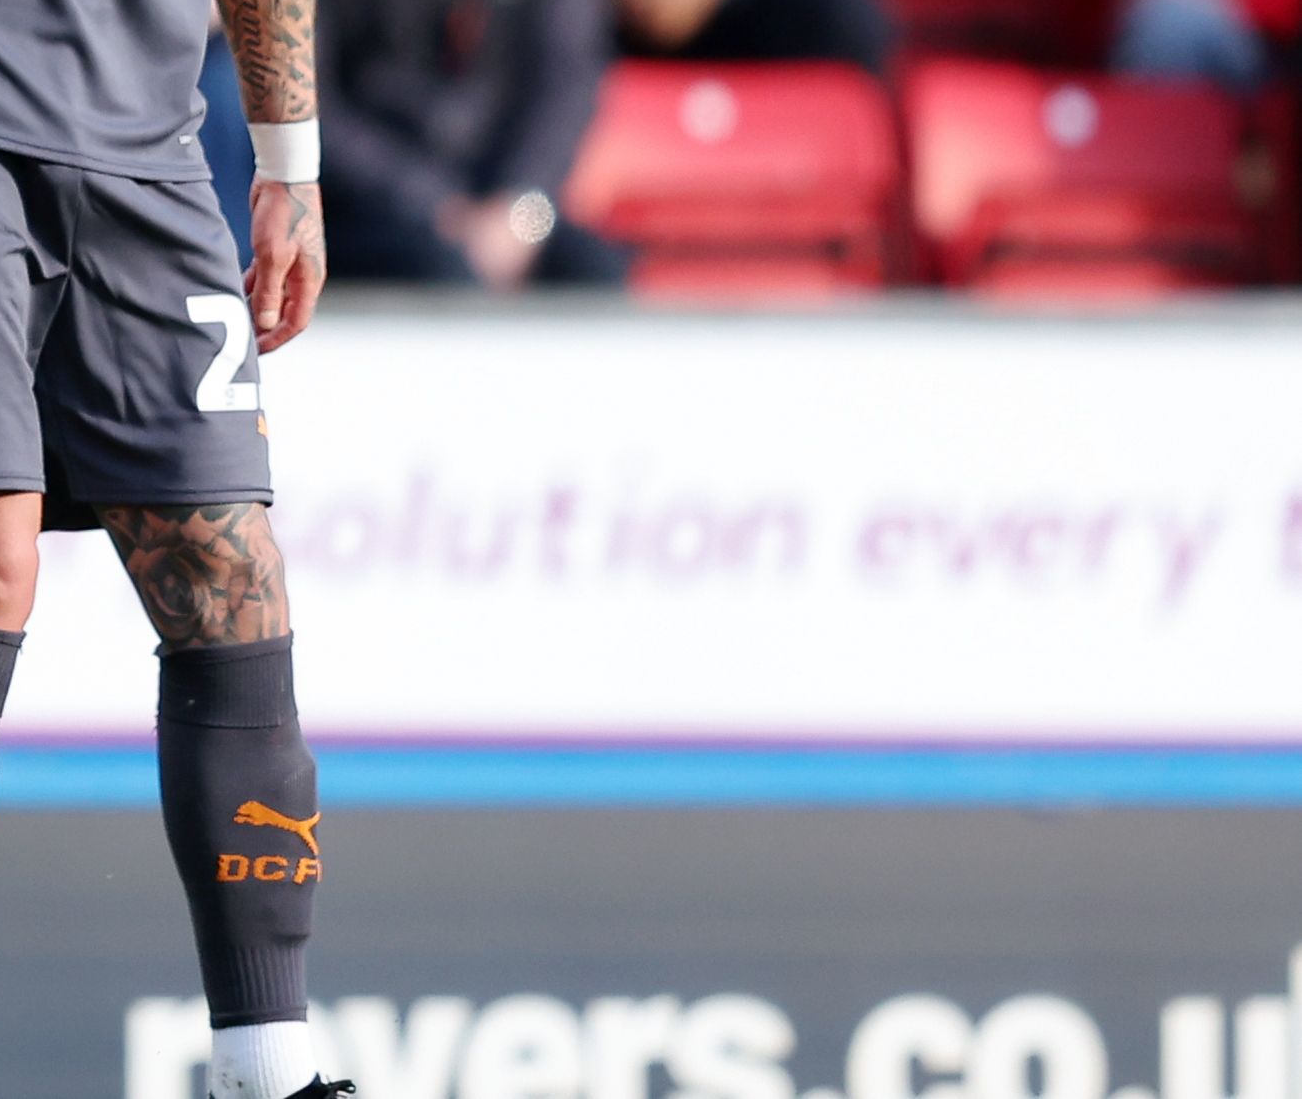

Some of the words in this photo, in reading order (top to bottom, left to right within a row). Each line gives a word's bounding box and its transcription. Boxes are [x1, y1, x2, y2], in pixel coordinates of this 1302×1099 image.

[185, 292, 258, 412] 2
[288, 466, 810, 581] olution
[217, 854, 323, 885] DCF
